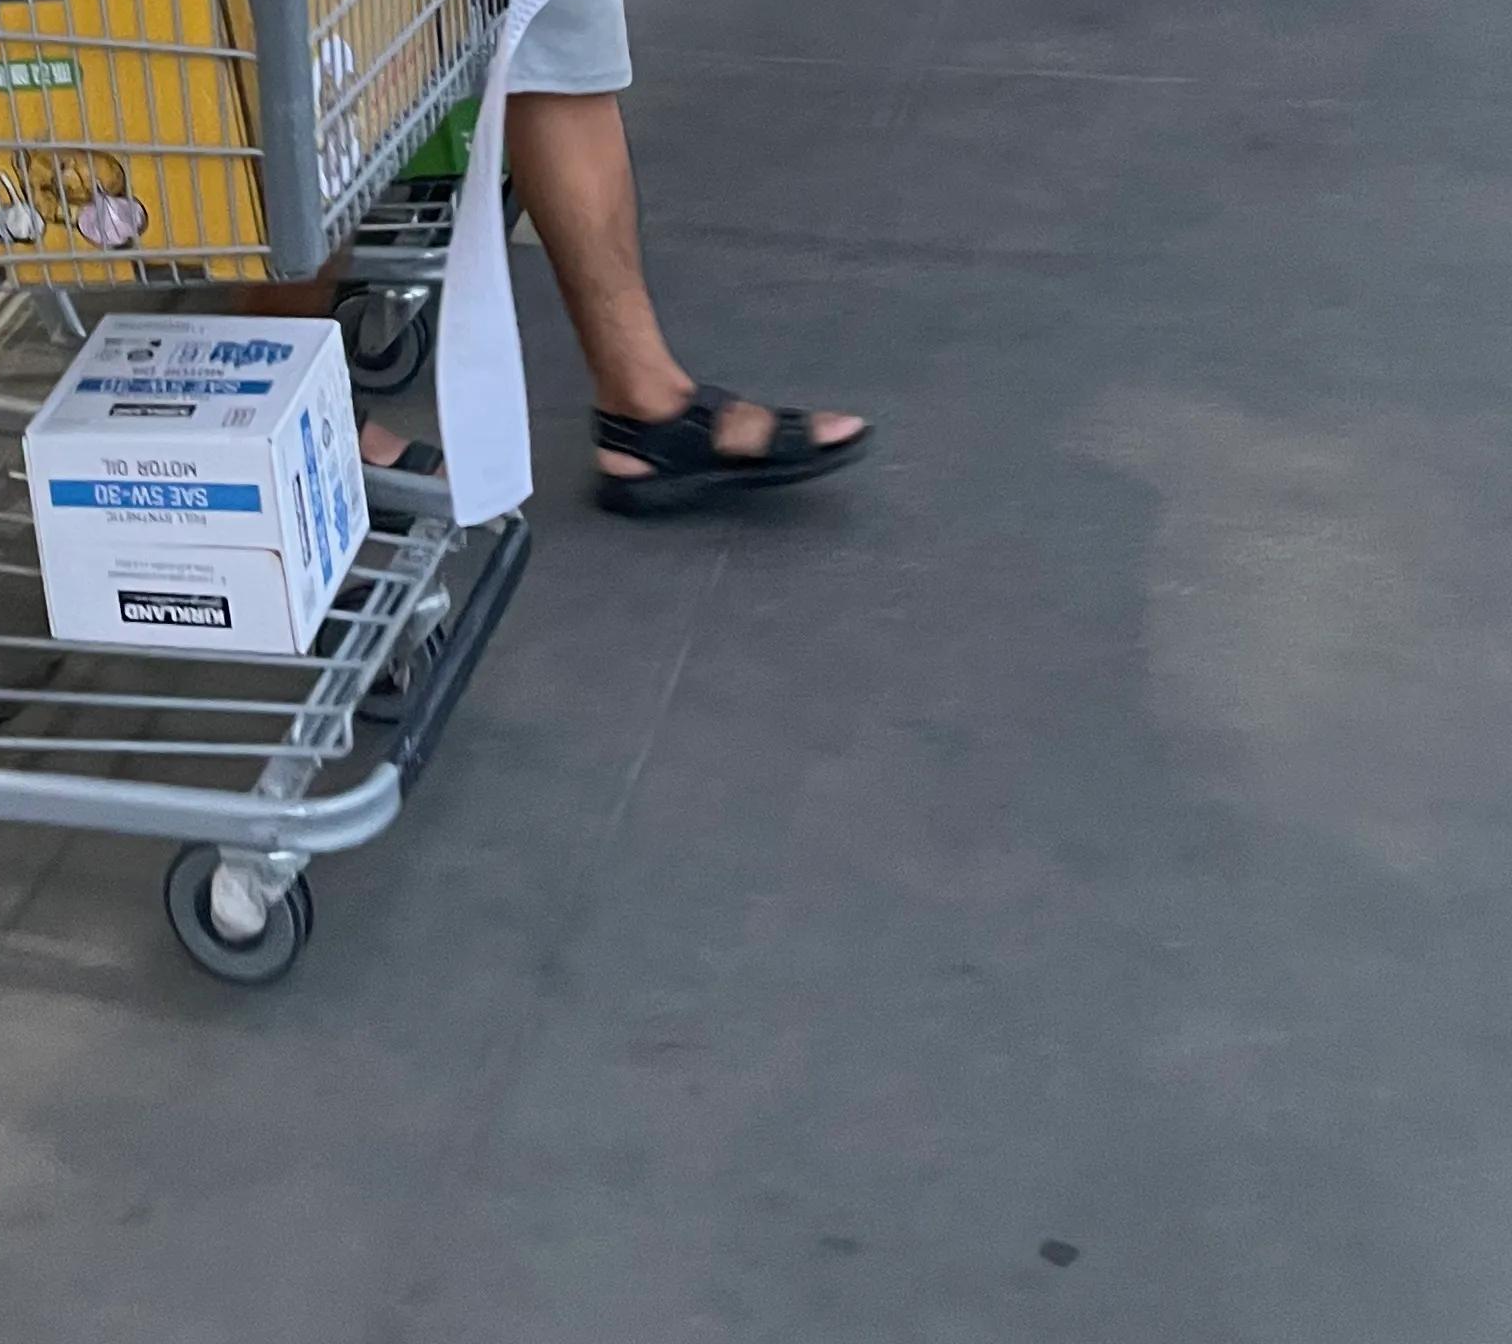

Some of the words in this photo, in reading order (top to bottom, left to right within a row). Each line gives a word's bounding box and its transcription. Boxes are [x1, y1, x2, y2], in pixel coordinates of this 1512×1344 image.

[100, 457, 129, 477] OIL
[136, 459, 199, 478] MOTOR
[94, 483, 165, 507] 5W-30
[167, 485, 209, 508] SAE
[123, 602, 227, 625] KIRKLAND
